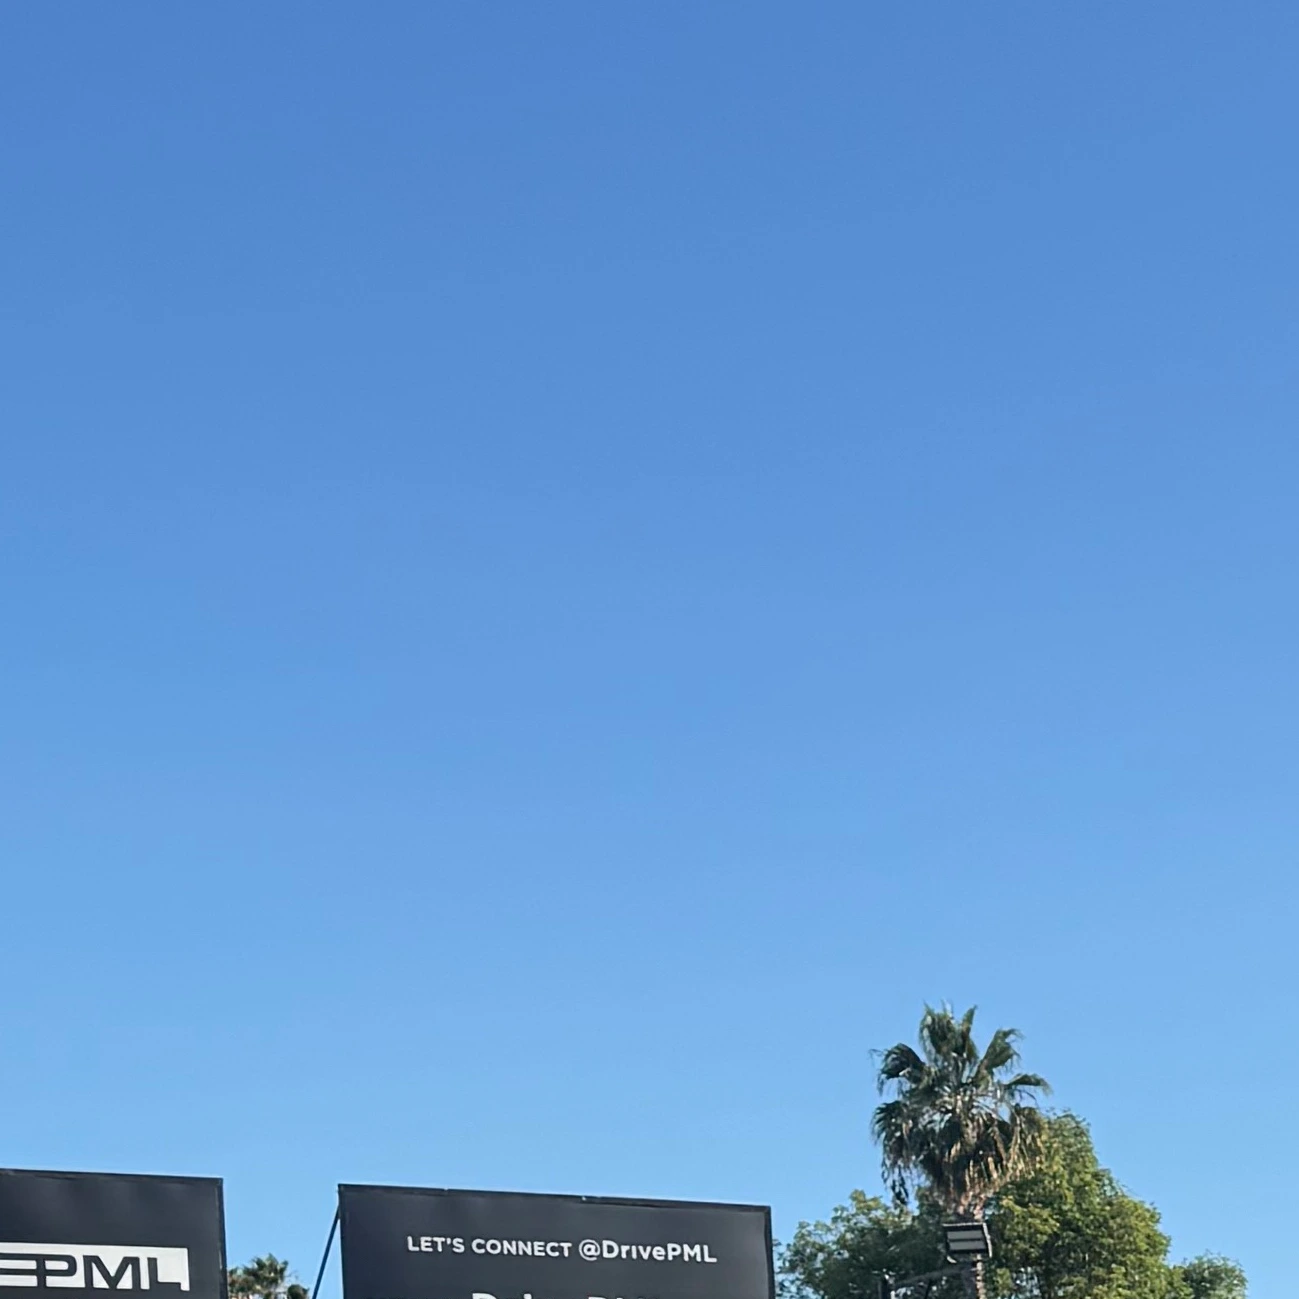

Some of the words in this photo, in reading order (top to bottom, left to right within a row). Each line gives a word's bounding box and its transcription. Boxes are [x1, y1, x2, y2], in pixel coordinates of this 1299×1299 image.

[406, 1235, 465, 1254] LET'S
[471, 1238, 573, 1258] CONNECT
[577, 1238, 718, 1263] @DrivePML
